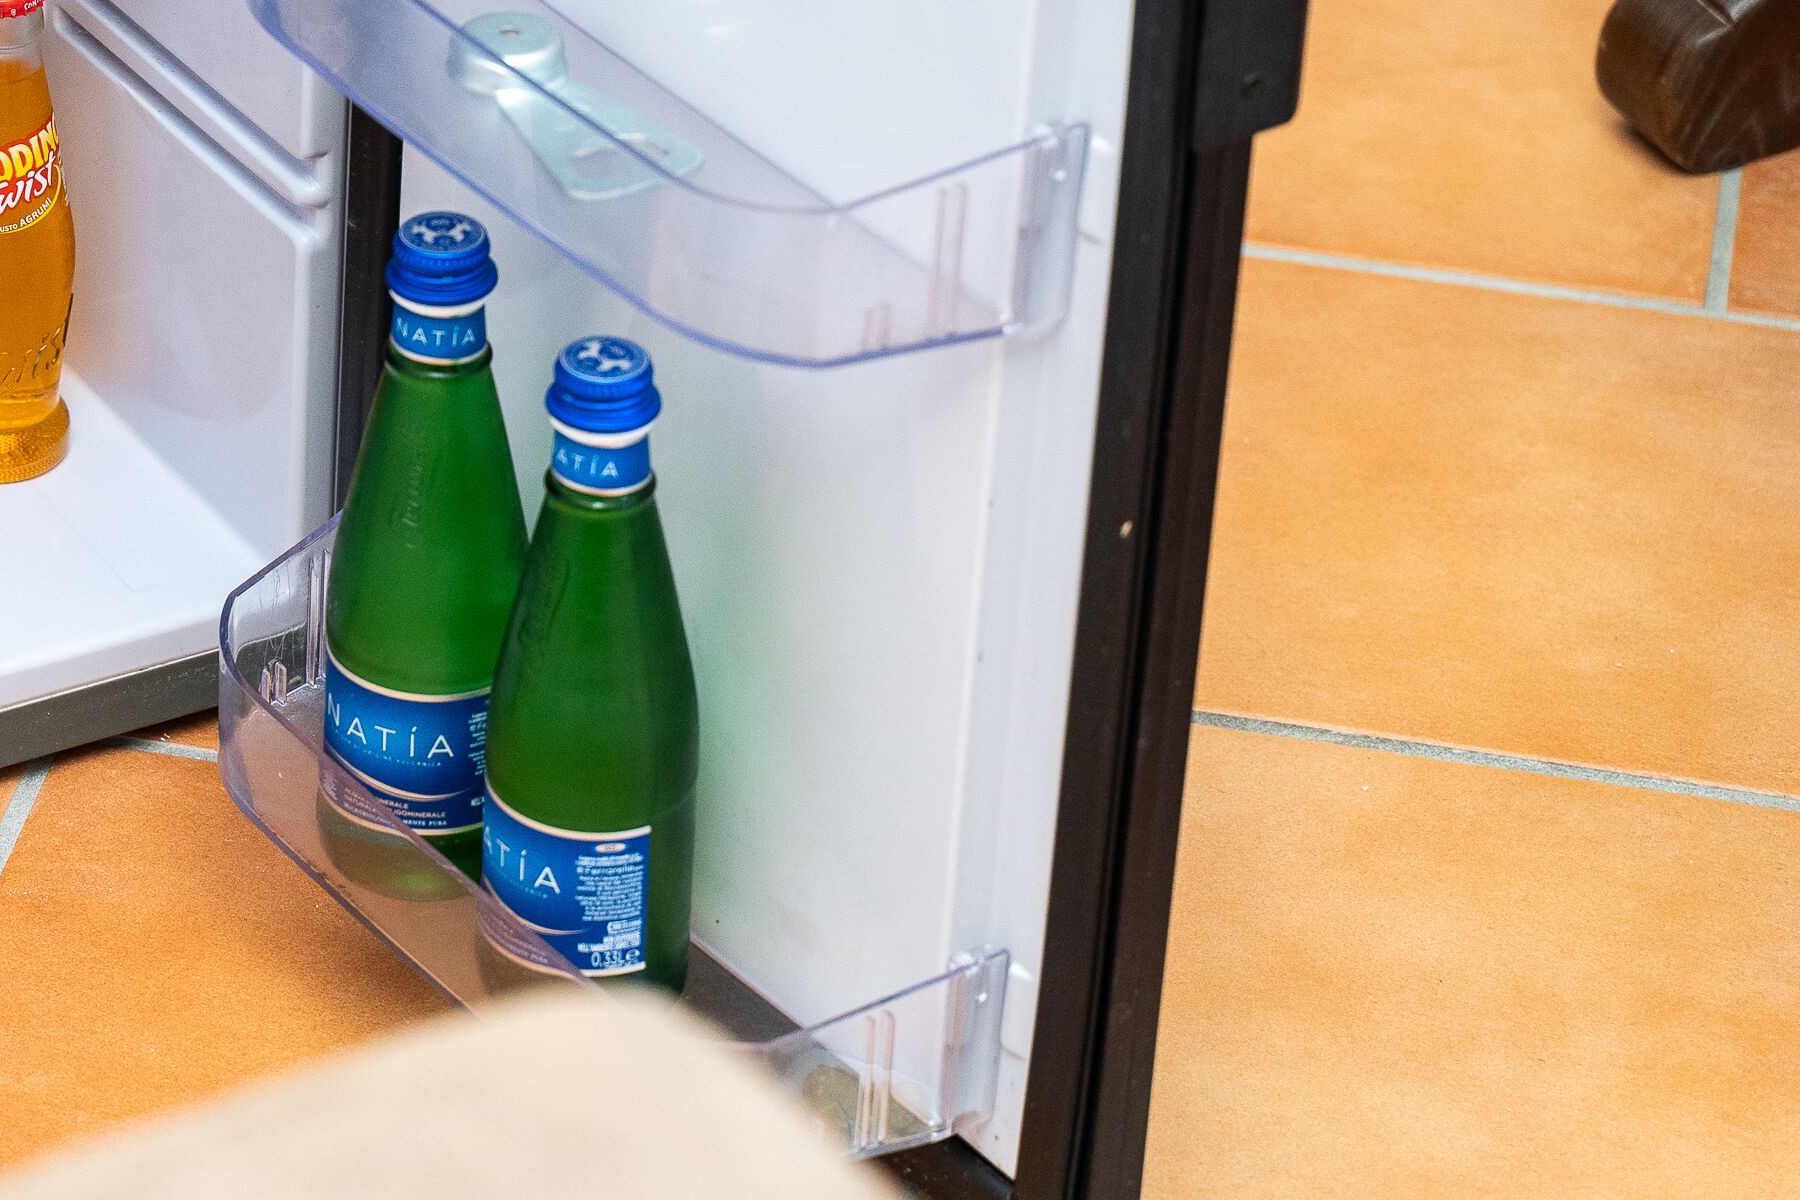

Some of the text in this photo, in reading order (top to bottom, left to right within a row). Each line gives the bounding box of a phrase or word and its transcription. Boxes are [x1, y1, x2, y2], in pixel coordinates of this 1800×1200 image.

[19, 197, 53, 227] AGRUMI
[397, 317, 476, 347] NATÍA
[327, 692, 454, 759] NATÍA
